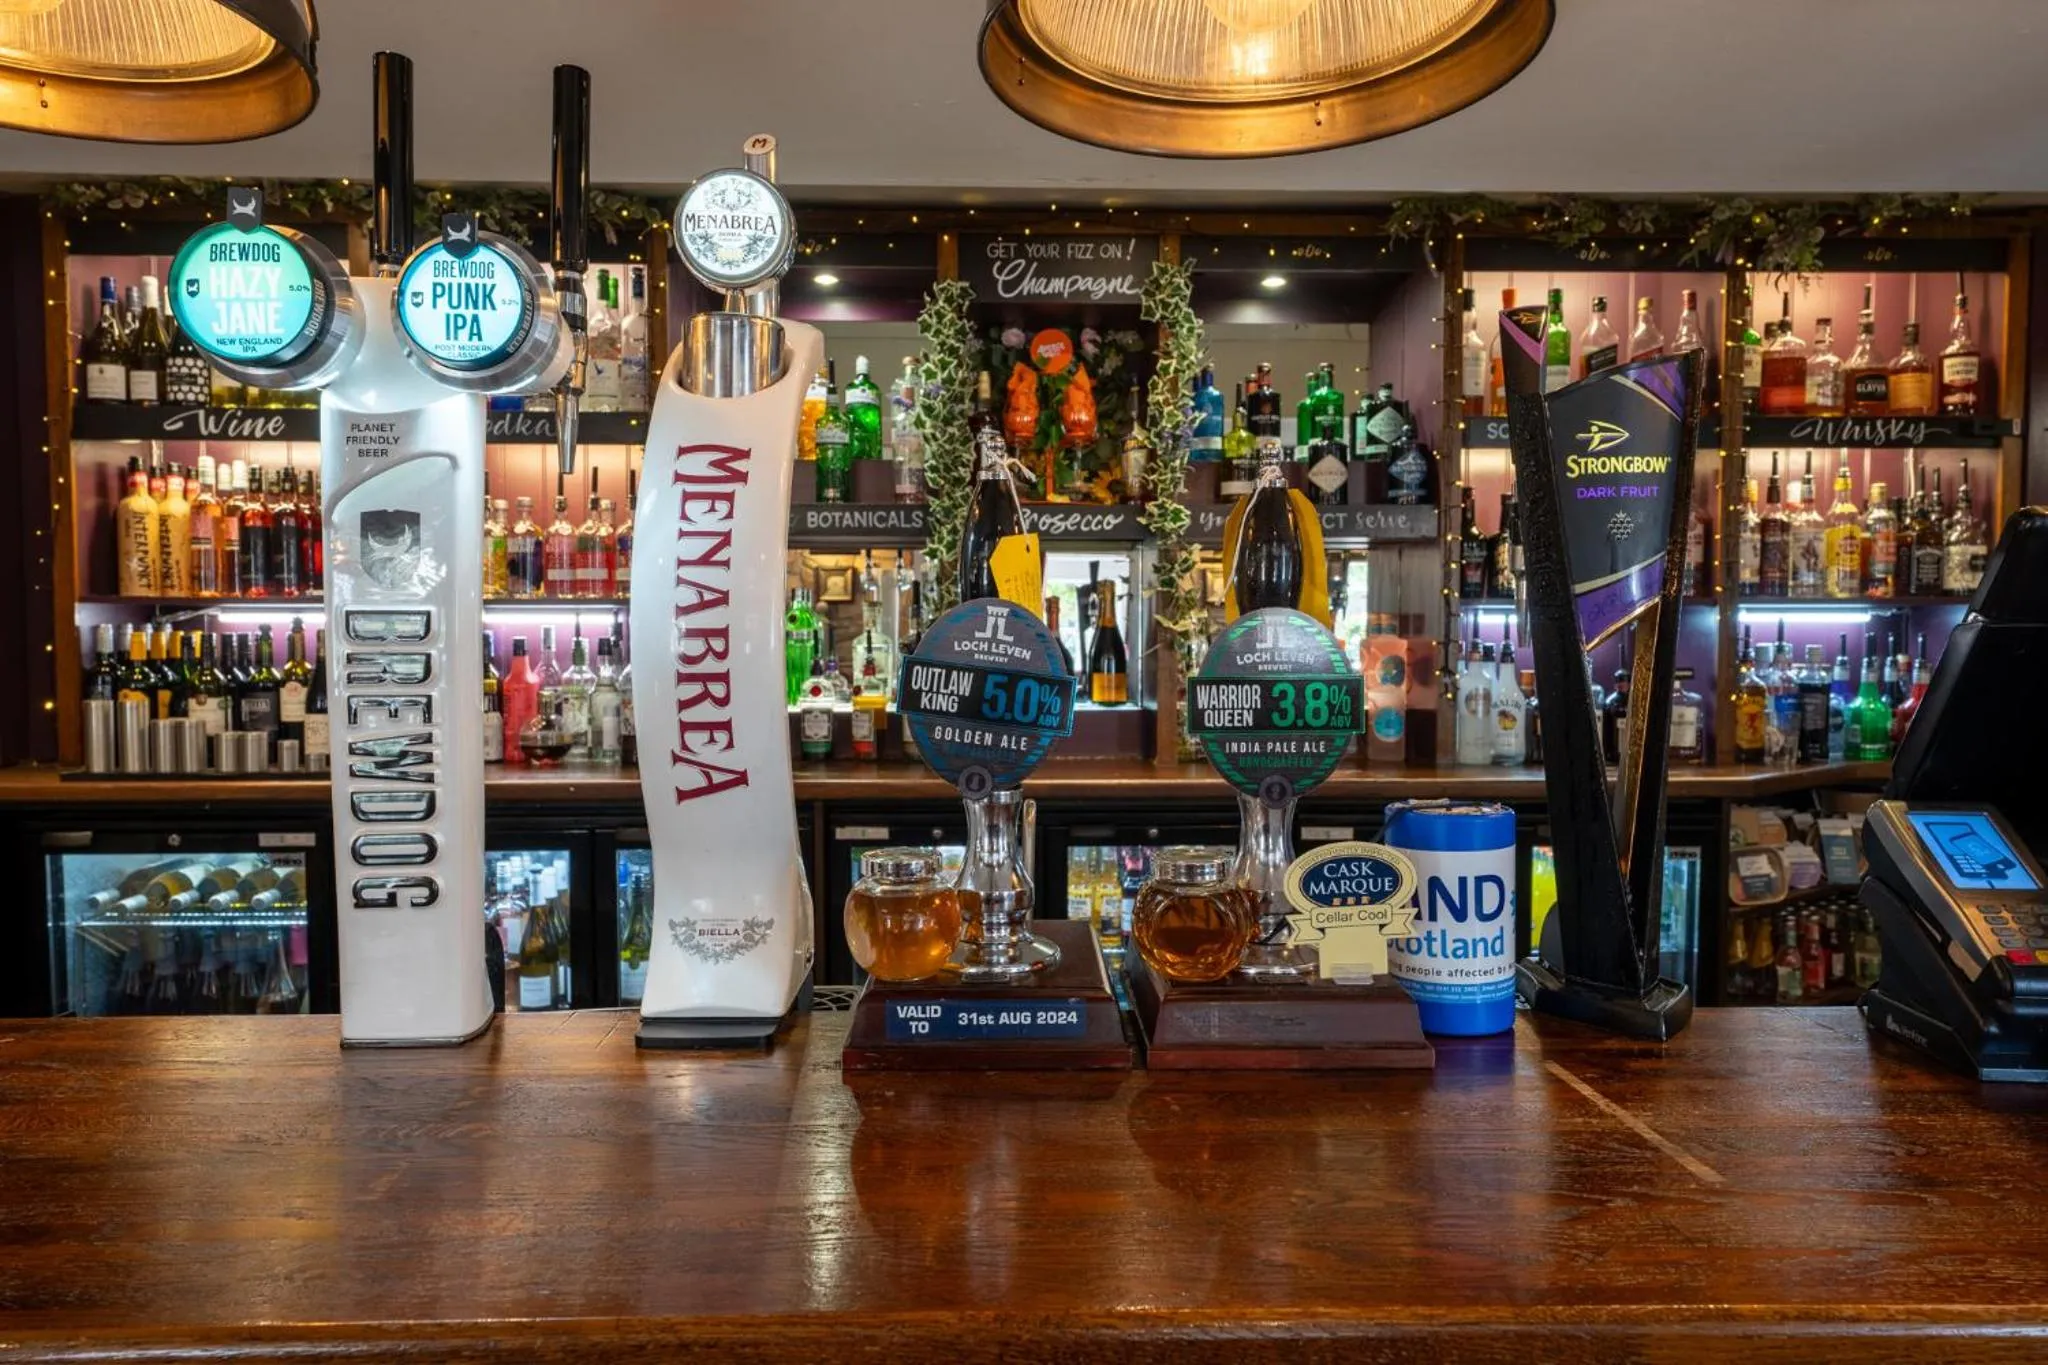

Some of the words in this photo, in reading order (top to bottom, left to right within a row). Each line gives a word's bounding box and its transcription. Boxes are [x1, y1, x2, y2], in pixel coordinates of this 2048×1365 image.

[752, 138, 767, 148] M
[684, 213, 777, 235] MENABREA
[209, 242, 281, 262] BREWDOG
[986, 242, 1017, 258] GET
[1024, 243, 1060, 258] YOUR
[1066, 243, 1094, 259] FIZZ
[433, 260, 495, 279] BREWDOG
[209, 267, 283, 299] HAZY
[992, 259, 1144, 300] Champagne
[432, 282, 497, 311] PUNK
[304, 278, 327, 337] BREWDOG
[211, 302, 285, 334] JANE
[445, 313, 483, 342] IPA
[216, 337, 236, 346] NEW
[239, 337, 283, 346] ENGLAND
[242, 345, 258, 353] IPA
[458, 344, 493, 352] MODERN
[163, 408, 285, 438] Wine
[351, 423, 396, 433] PLANET
[487, 412, 556, 437] odka
[1790, 418, 1951, 446] Whisky
[346, 436, 400, 445] FRIENDLY
[358, 449, 389, 458] BEER
[1566, 454, 1668, 478] STRONGBOW
[1576, 486, 1617, 499] DARK
[1620, 486, 1660, 498] FRUIT
[807, 511, 924, 529] BOTANICALS
[1355, 511, 1411, 530] serve
[671, 444, 752, 806] MENABREA
[953, 640, 990, 651] LOCH
[991, 642, 1032, 660] LEVEN
[1236, 652, 1271, 665] LOCH
[1274, 651, 1315, 664] LEVEN
[911, 665, 974, 697] OUTLAW
[981, 673, 1062, 723] 5.0%
[920, 691, 960, 713] KING
[1037, 715, 1060, 727] ABV
[1196, 684, 1261, 709] WARRIOR
[1271, 682, 1351, 727] 3.8%
[1204, 710, 1254, 727] QUEEN
[1330, 716, 1352, 728] ABV
[934, 725, 993, 746] GOLDEN
[1000, 735, 1028, 750] ALE
[1226, 742, 1260, 753] INDIA
[1267, 741, 1297, 753] PALE
[1303, 741, 1326, 753] ALE
[345, 609, 439, 909] BREWDOG
[1323, 861, 1375, 878] CASK
[1309, 877, 1395, 896] MARQUE
[1315, 911, 1354, 924] Cellar
[1358, 909, 1388, 921] Cool
[698, 928, 741, 936] BIELLA
[1405, 965, 1442, 977] people
[1447, 966, 1495, 977] affected
[896, 1005, 942, 1018] VALID
[958, 1012, 994, 1025] 31st
[998, 1012, 1032, 1025] AUG
[1036, 1011, 1078, 1024] 2024
[909, 1021, 929, 1034] TO
